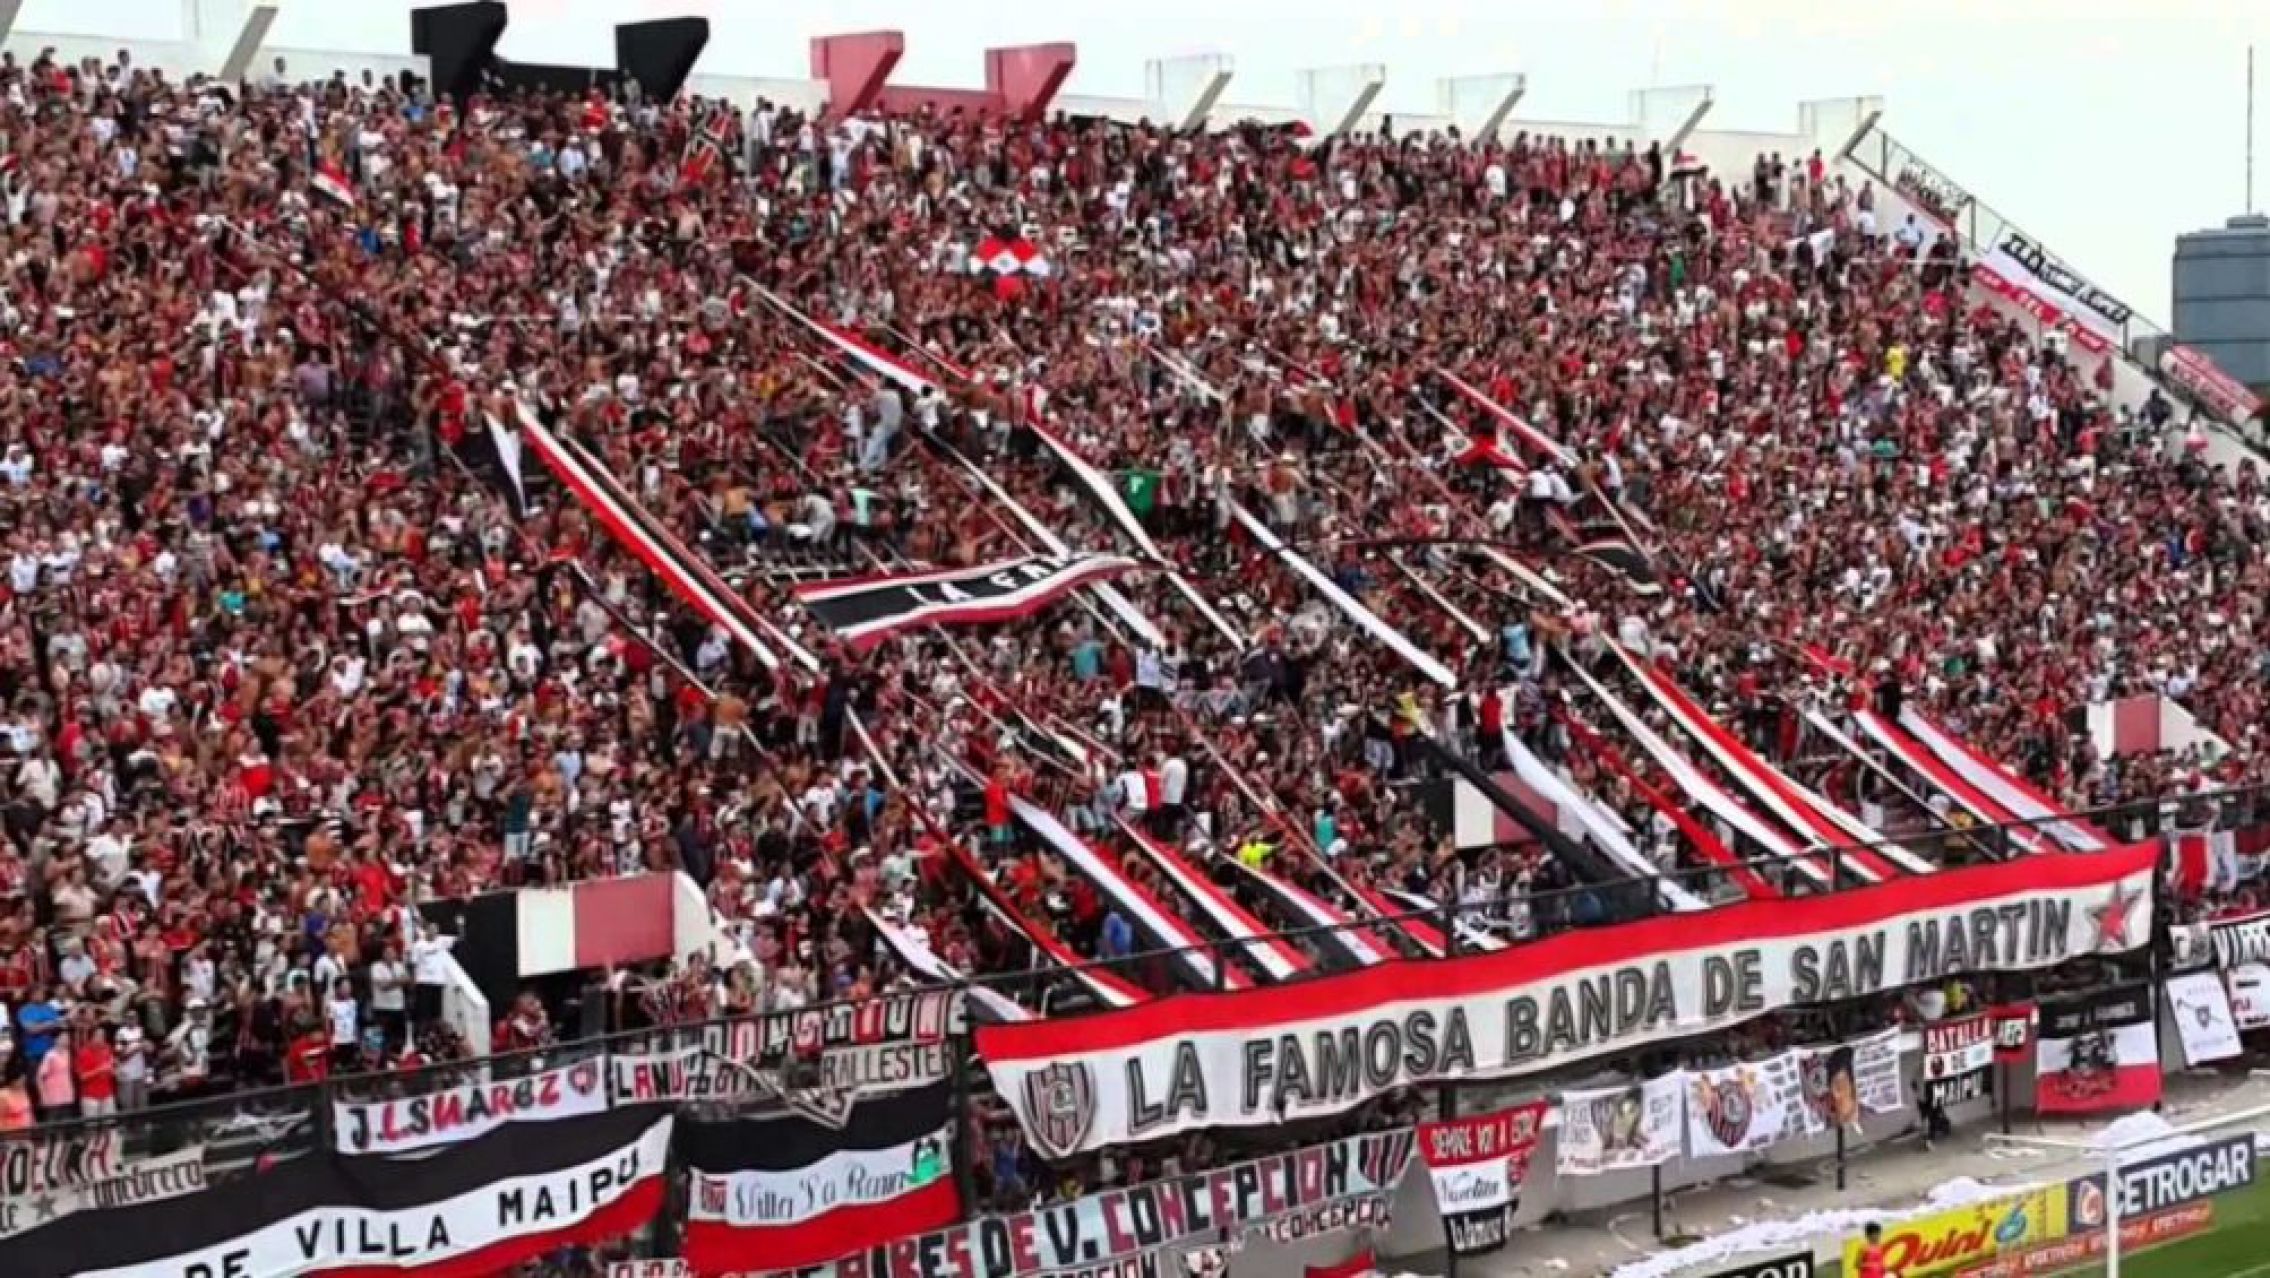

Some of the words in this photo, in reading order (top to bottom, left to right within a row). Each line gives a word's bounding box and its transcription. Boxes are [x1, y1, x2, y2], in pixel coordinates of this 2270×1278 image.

[1126, 1038, 1208, 1136] LA
[1240, 1006, 1476, 1117] FAMOSA
[1503, 960, 1678, 1066] BANDA
[1703, 948, 1764, 1020] DE
[1790, 930, 1885, 1003] SAN
[1906, 898, 2070, 982] MARTIN
[295, 1213, 452, 1262] VILLA
[498, 1147, 640, 1228] MAIPU
[733, 1176, 794, 1221] Villa
[979, 1214, 1041, 1278] DE
[1044, 1205, 1099, 1266] V.
[1100, 1140, 1350, 1255] CONCEPCION
